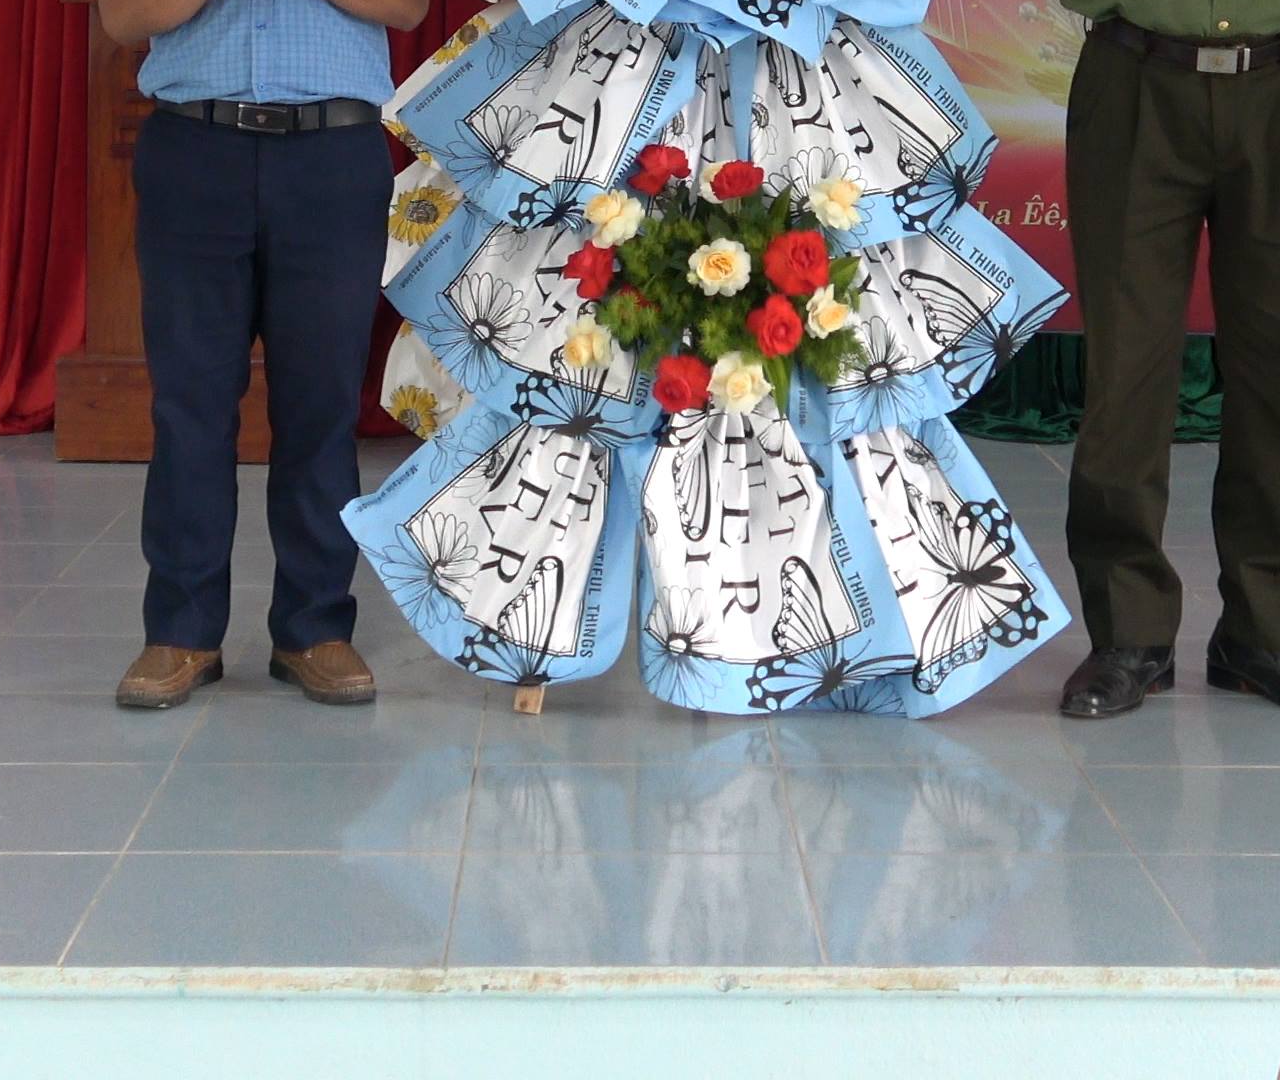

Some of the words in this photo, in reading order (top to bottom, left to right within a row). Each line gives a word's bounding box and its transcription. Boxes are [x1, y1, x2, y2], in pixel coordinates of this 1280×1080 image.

[968, 246, 1015, 290] THINGS
[847, 571, 876, 629] THINGS
[579, 604, 601, 659] THINGS
